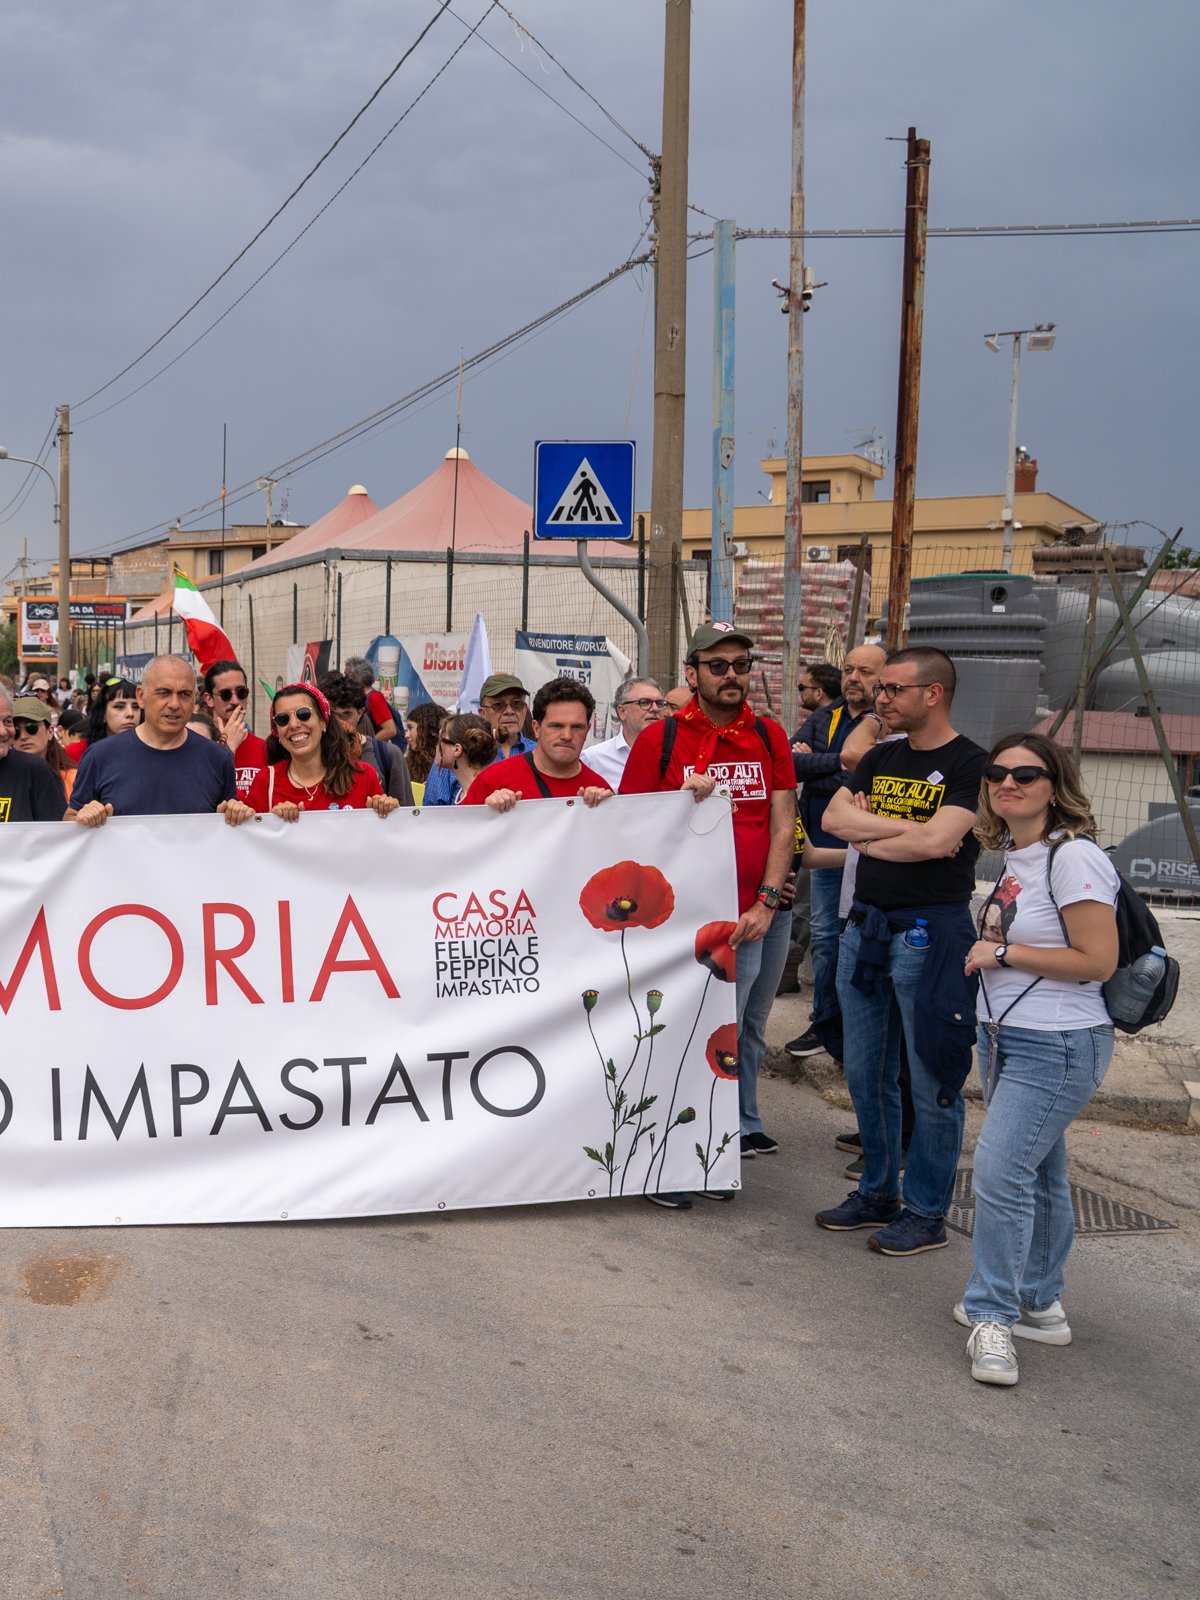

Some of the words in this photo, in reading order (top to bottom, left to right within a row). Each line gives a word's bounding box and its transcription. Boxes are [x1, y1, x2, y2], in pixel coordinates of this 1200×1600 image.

[528, 637, 574, 651] RIVENDITORE
[578, 671, 592, 685] 51
[734, 765, 760, 779] AUT
[872, 780, 905, 797] RADIO
[905, 783, 942, 802] AUT
[432, 888, 537, 923] CASA
[434, 918, 537, 940] MEMORIA
[434, 938, 520, 961] FELICIA
[527, 936, 539, 956] E
[435, 955, 540, 981] PEPPINO
[436, 977, 540, 998] IMPASTATO
[51, 1045, 546, 1141] IMPASTATO
